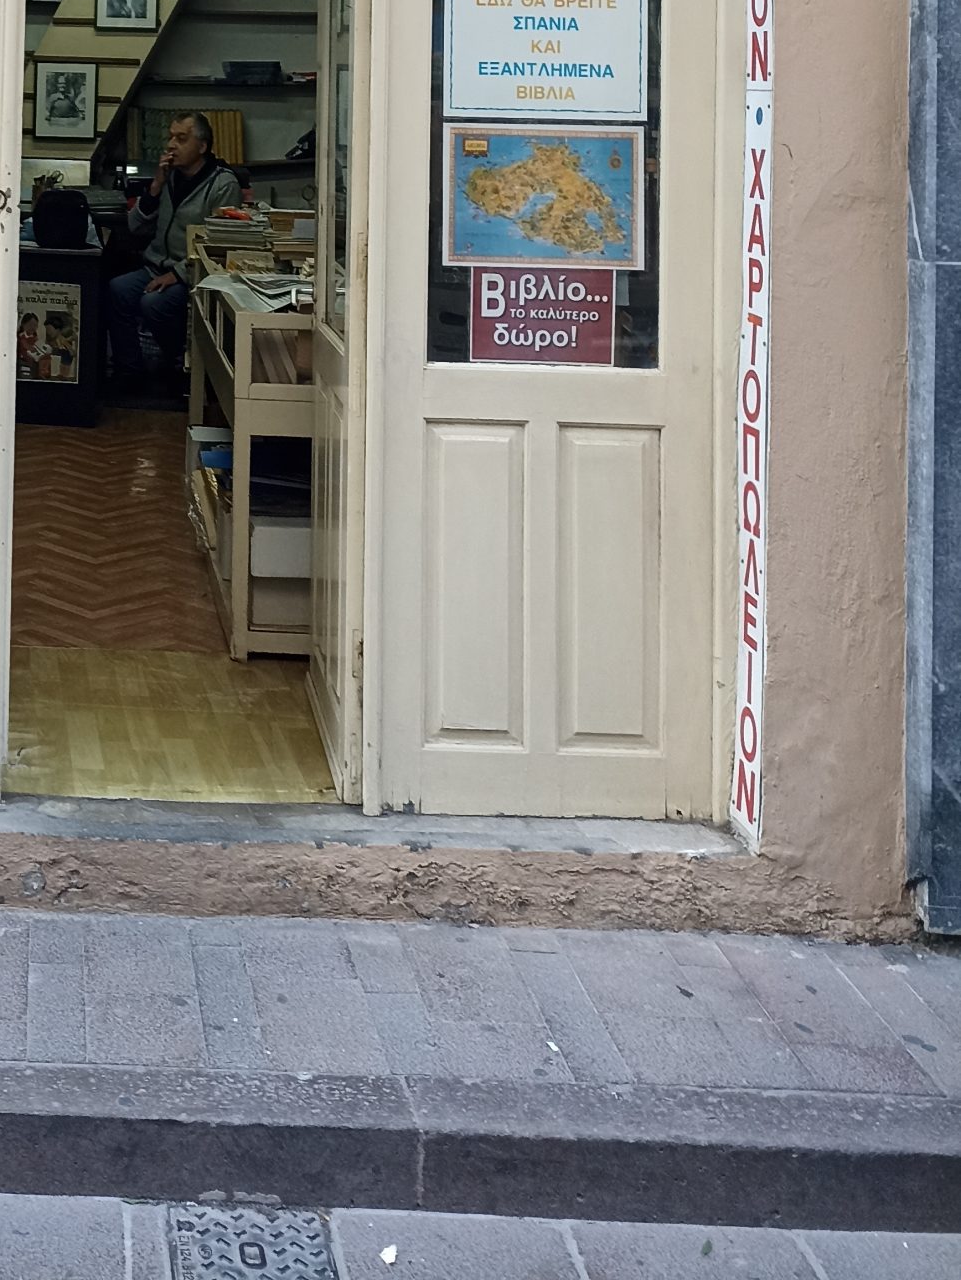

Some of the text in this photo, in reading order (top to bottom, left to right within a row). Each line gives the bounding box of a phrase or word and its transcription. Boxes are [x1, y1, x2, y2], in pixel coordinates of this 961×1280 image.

[513, 16, 579, 31] ΣΠΑΝΙΑ
[531, 40, 561, 54] ΚΑΙ
[478, 62, 614, 78] ΕΞΑΝΤΛΗΜΕΝΑ
[516, 86, 576, 100] ΒΙΒΛΙΑ
[510, 307, 599, 322] το καλύτερο
[493, 323, 577, 351] δώρο!
[737, 148, 766, 825] ΧΑΡΤΟΠΩΛΕΙΟΝ
